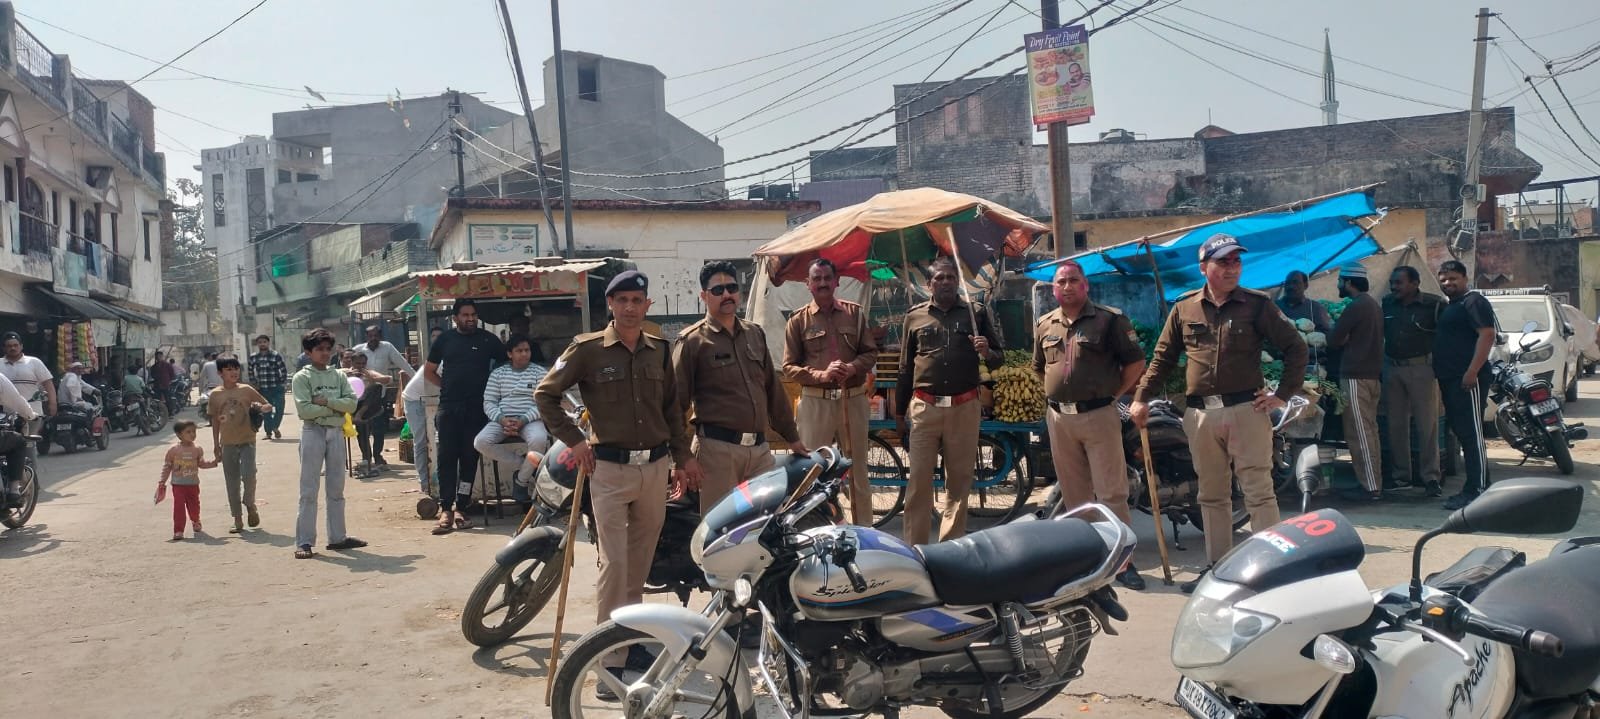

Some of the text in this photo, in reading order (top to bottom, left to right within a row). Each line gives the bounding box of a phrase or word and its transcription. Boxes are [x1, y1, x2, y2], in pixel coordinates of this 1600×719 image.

[1030, 37, 1044, 49] Dry
[1045, 33, 1062, 46] Fruit
[1063, 31, 1080, 42] Point
[1211, 237, 1238, 249] POLICE
[1505, 288, 1530, 296] PERMIT
[1448, 641, 1492, 717] Apache
